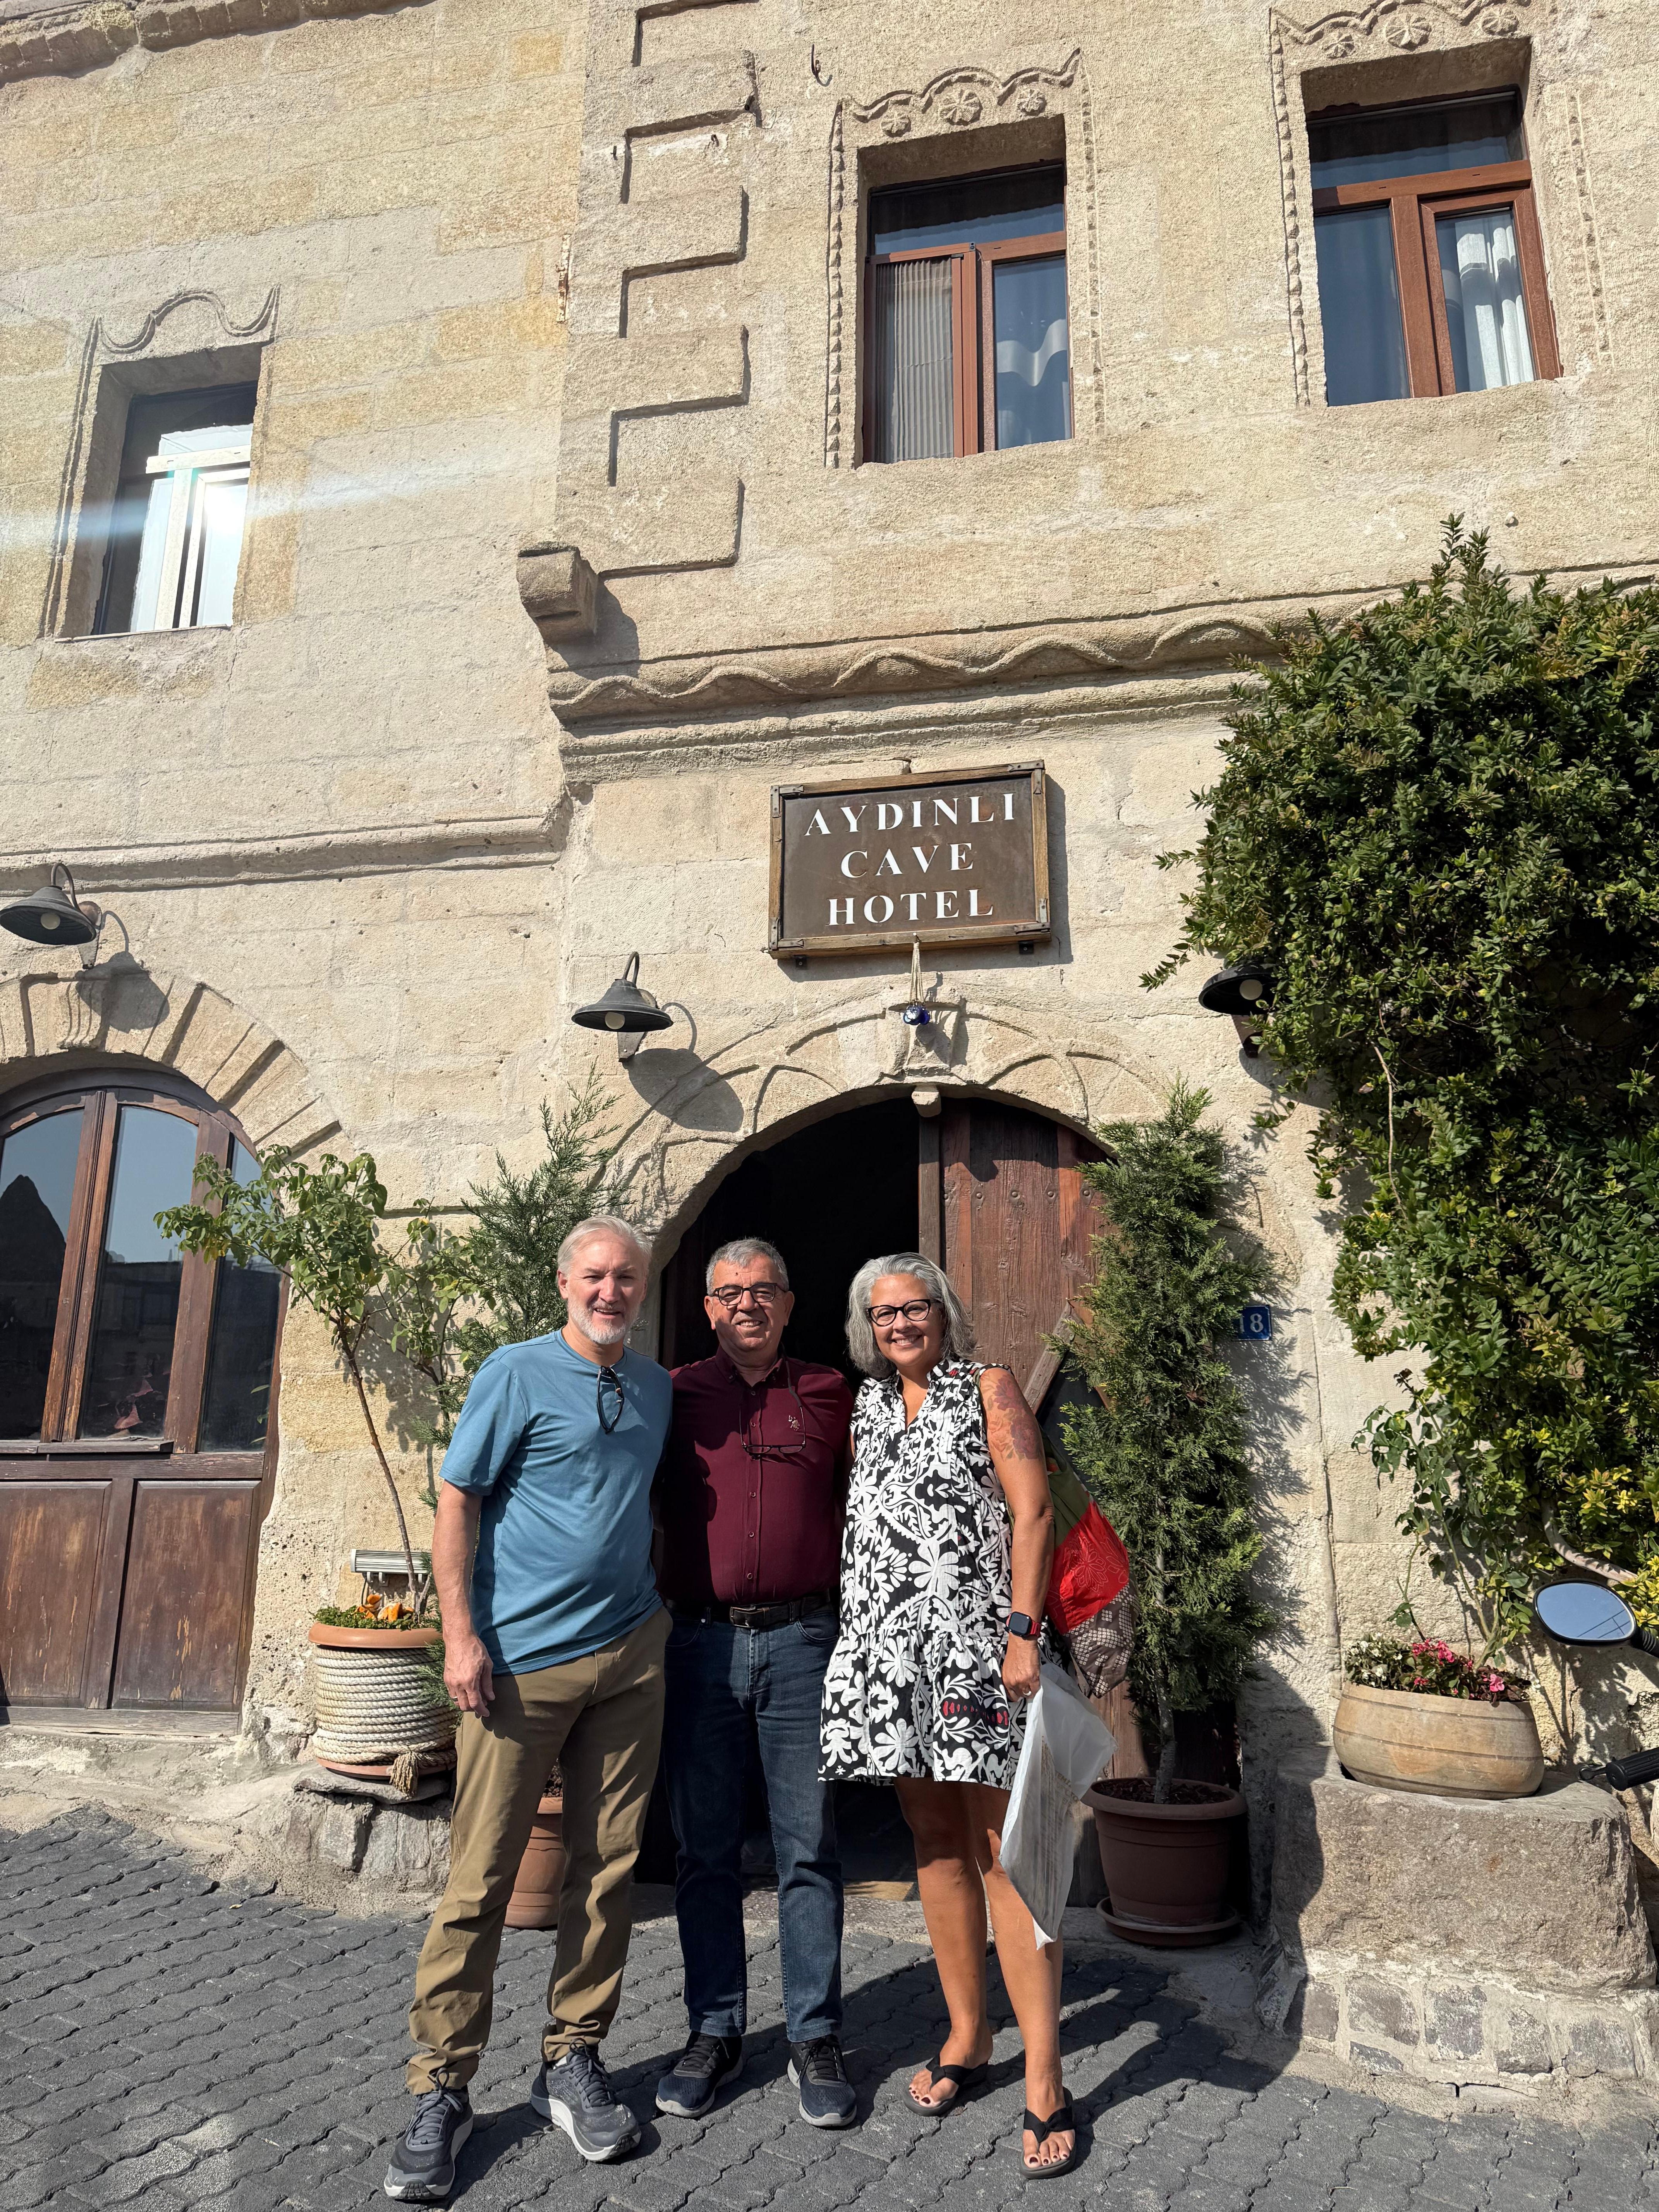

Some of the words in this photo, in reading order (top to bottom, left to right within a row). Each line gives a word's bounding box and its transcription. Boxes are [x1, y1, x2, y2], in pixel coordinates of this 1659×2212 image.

[804, 793, 1015, 836] AYDINLI
[841, 842, 974, 878] CAVE
[828, 889, 994, 926] HOTEL
